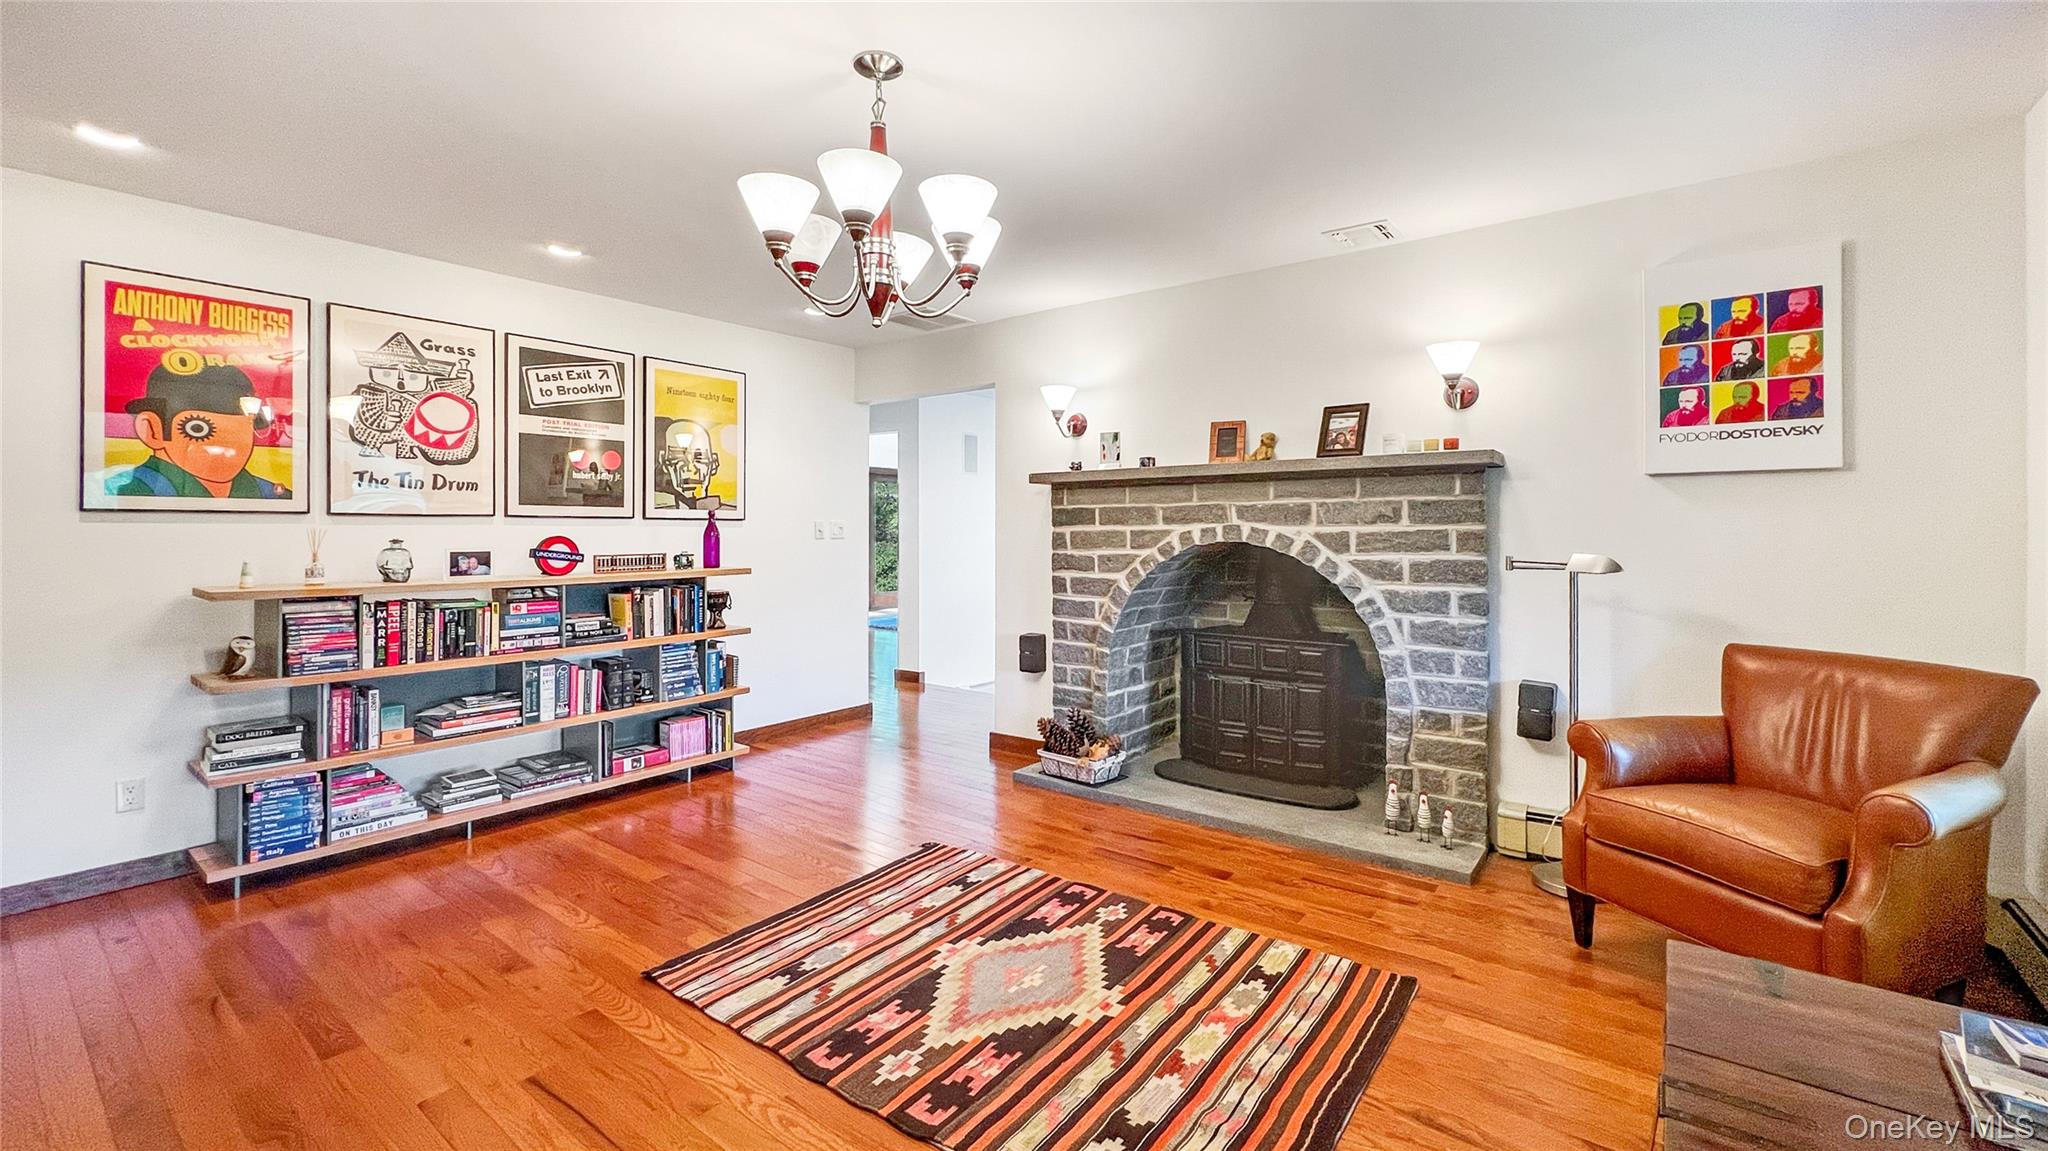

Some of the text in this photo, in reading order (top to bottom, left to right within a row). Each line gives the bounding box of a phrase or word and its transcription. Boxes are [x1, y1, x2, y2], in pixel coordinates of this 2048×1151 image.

[113, 288, 290, 338] ANTHONY BURGESS
[133, 318, 155, 332] A
[120, 334, 283, 350] CLOCKWORK
[419, 338, 477, 358] Grass
[161, 348, 266, 375] ORA
[535, 369, 592, 383] Last Exit
[539, 383, 613, 397] to Brooklyn
[352, 470, 479, 492] The Tin Drum
[535, 551, 583, 560] UNDERGROUND
[376, 610, 387, 647] MARR
[388, 610, 401, 635] PEEL
[355, 824, 374, 834] THIS
[377, 820, 394, 829] DAY
[266, 848, 285, 857] Italy
